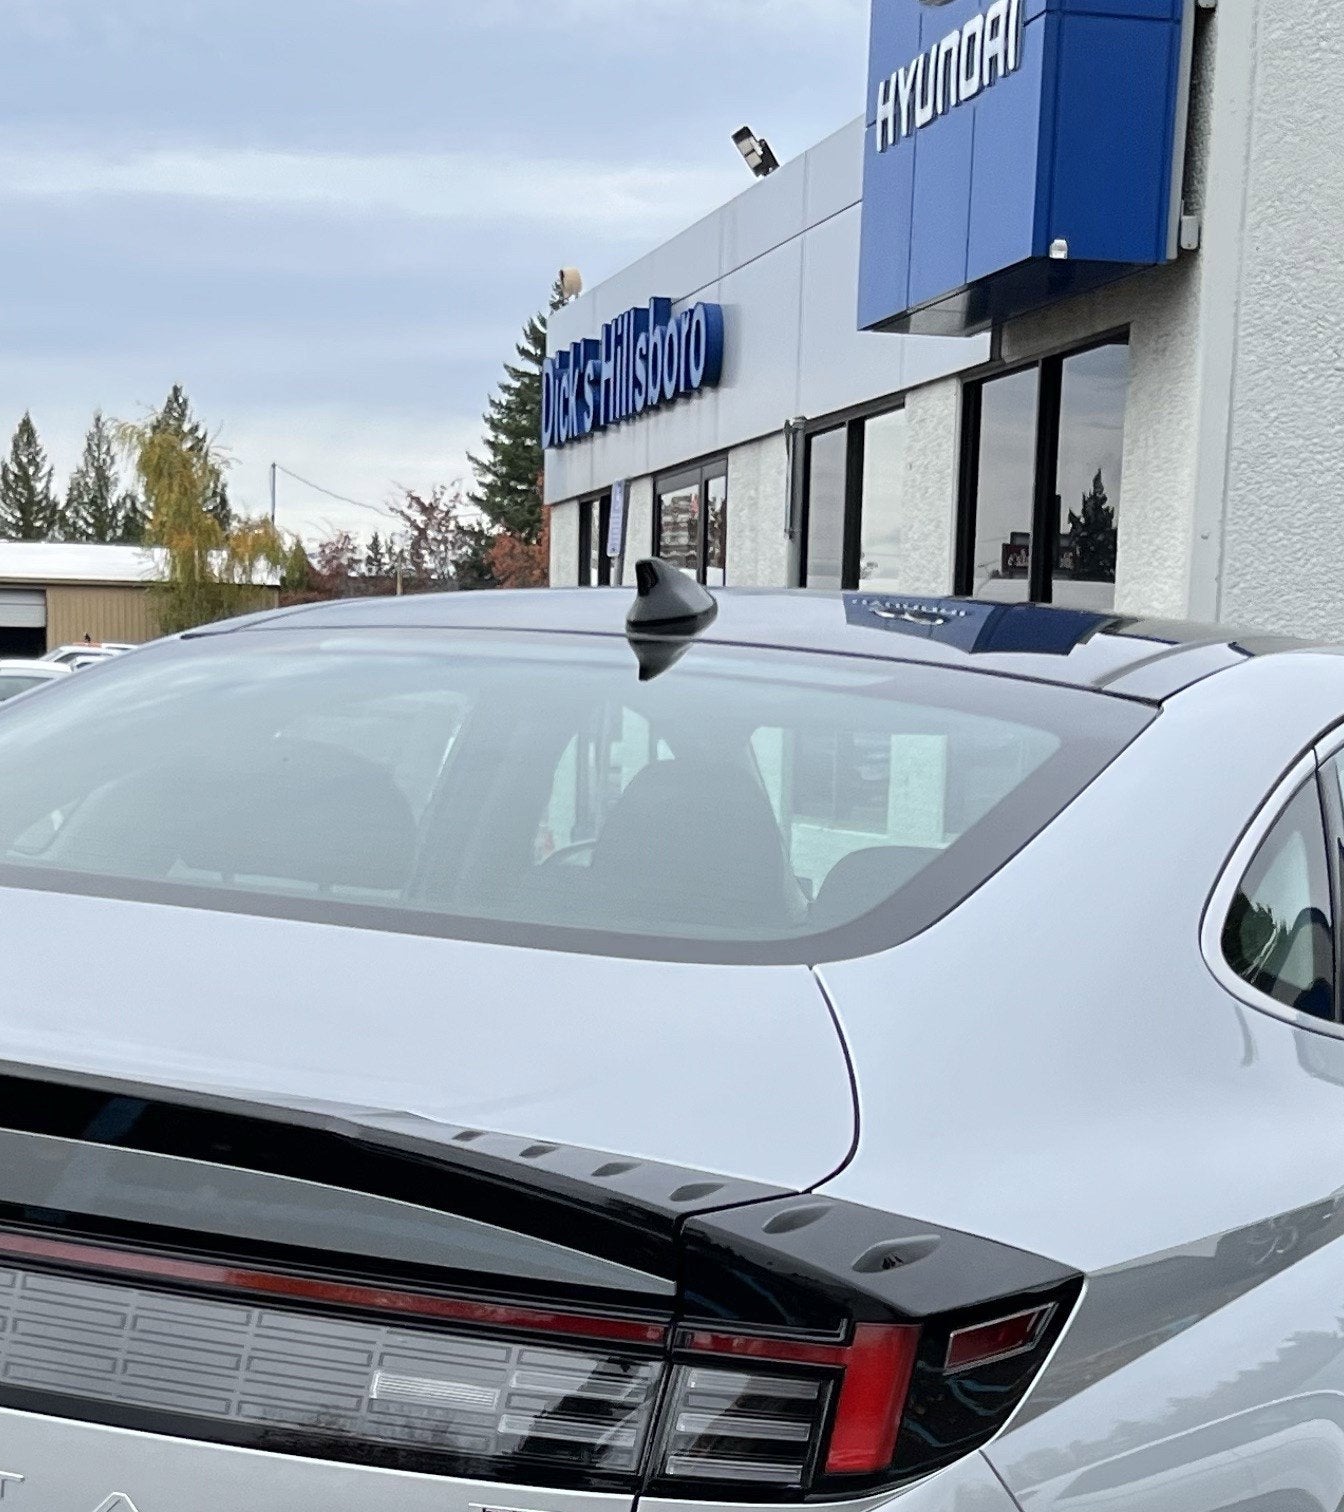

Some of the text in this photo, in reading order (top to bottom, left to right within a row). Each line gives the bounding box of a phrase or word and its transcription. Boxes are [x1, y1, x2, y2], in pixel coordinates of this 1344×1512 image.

[876, 0, 1019, 153] HYUNDAI
[542, 297, 707, 449] Dick's Hillsboro
